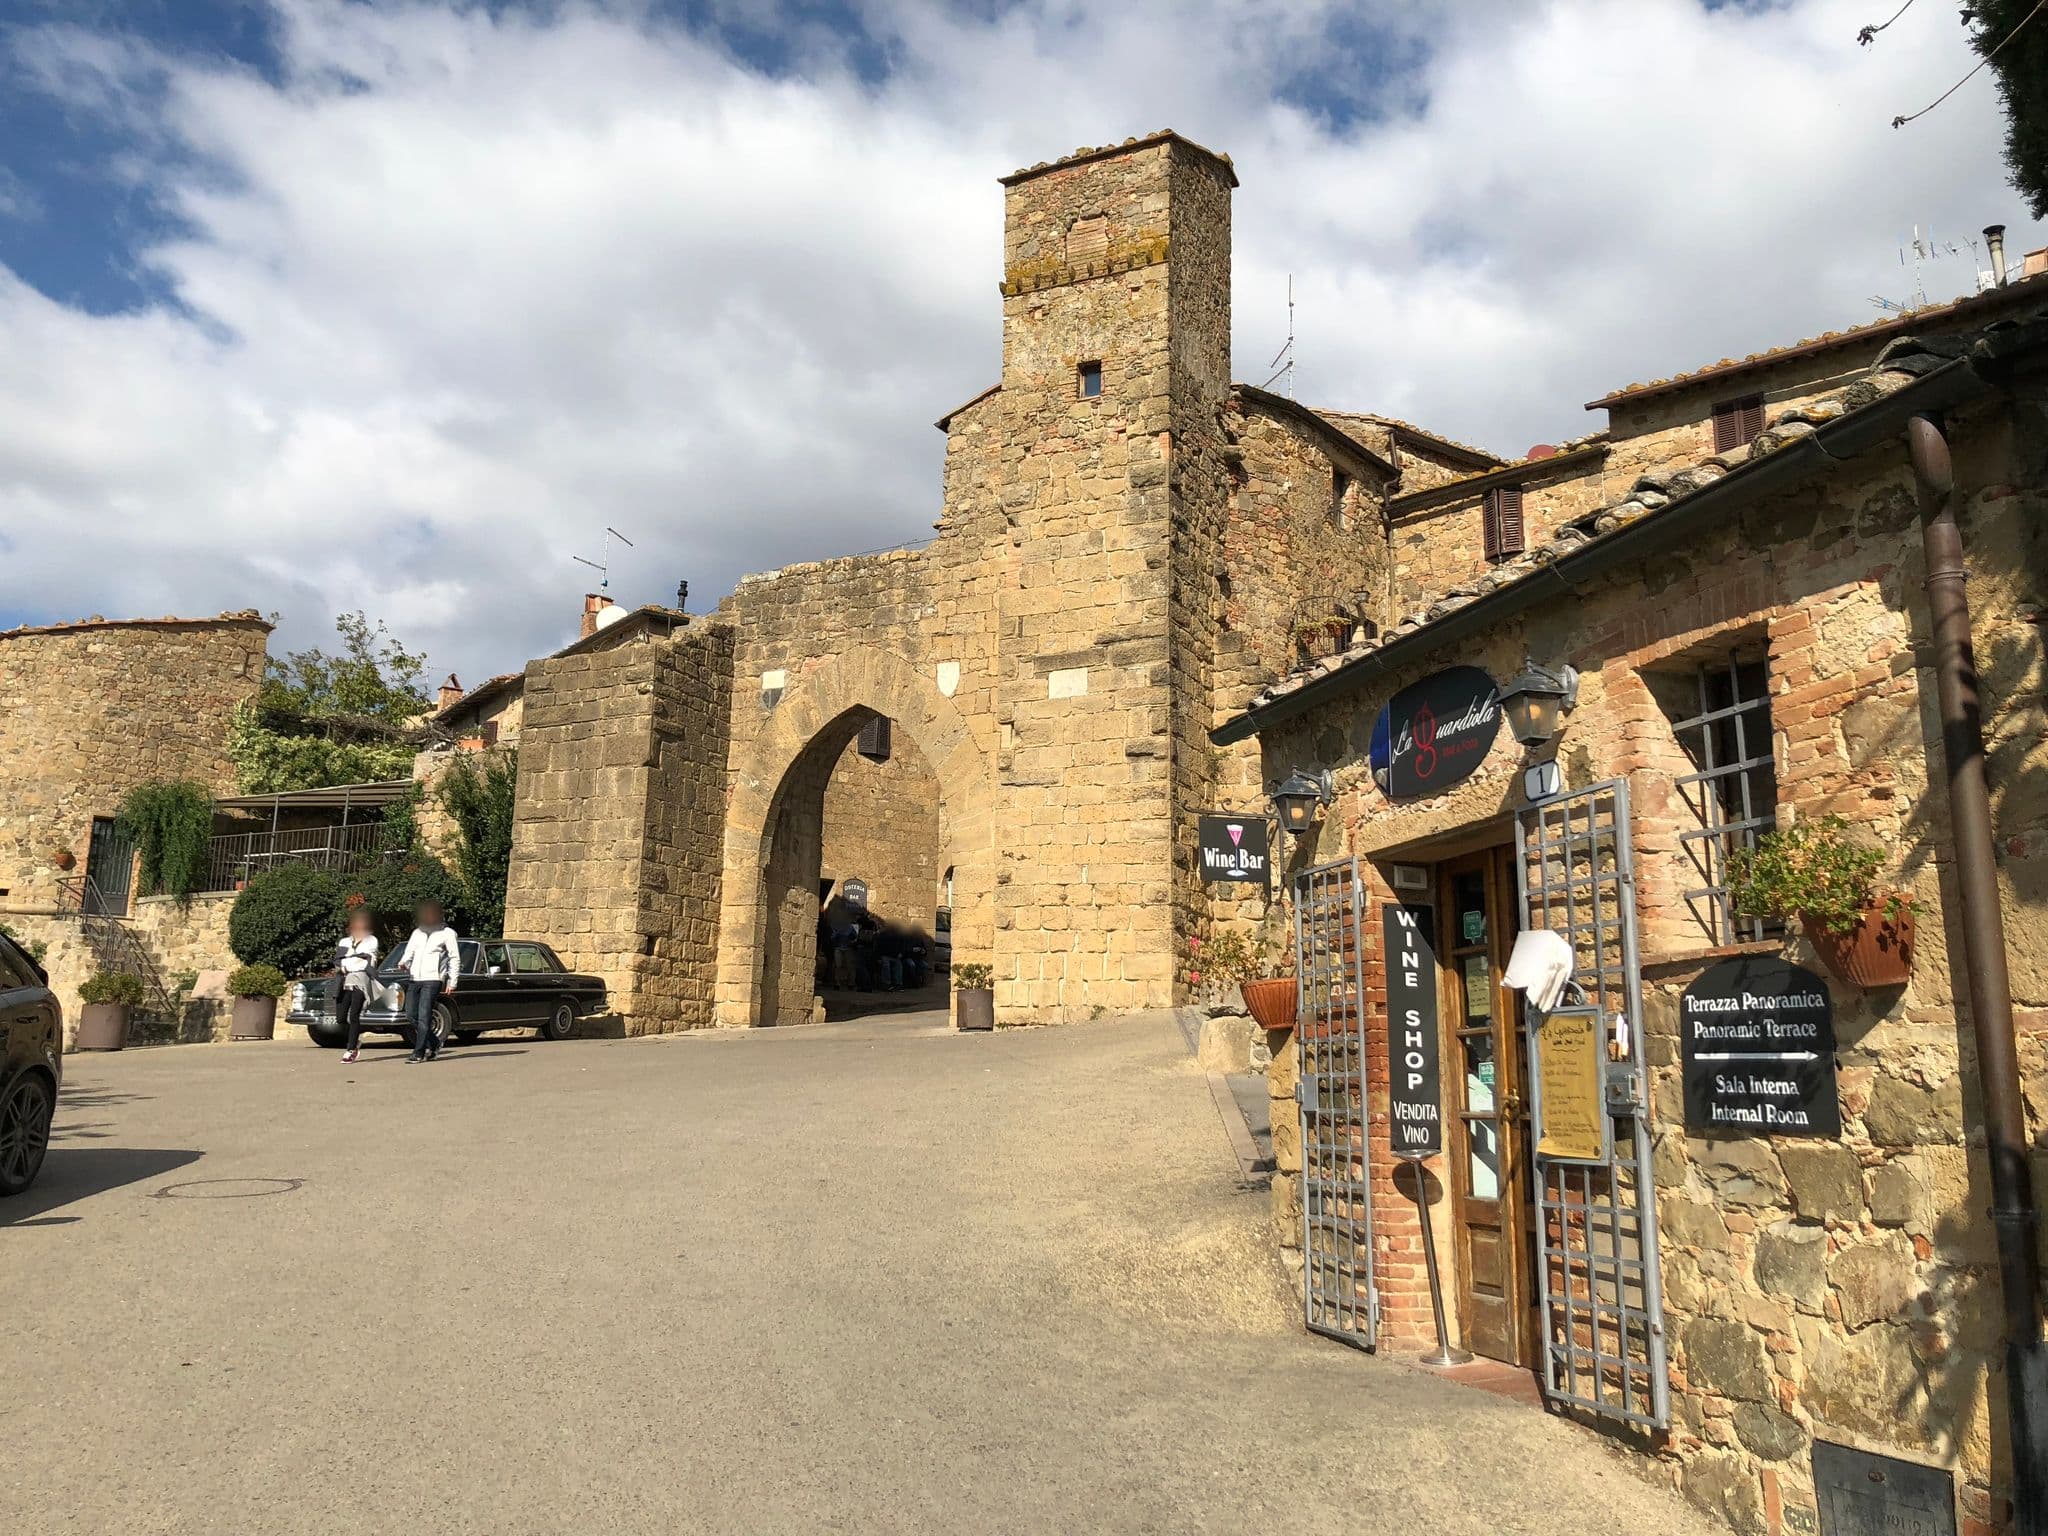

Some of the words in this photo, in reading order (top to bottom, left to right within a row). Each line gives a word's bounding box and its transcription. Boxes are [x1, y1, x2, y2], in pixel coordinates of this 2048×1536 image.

[1391, 718, 1413, 765] La
[1535, 767, 1547, 794] 1
[1203, 847, 1236, 868] Wine
[1239, 848, 1264, 869] Bar
[1396, 910, 1419, 987] WINE
[1685, 994, 1740, 1013] Terrazza
[1742, 990, 1825, 1011] Panoramica
[1693, 1020, 1761, 1039] Panoramic
[1763, 1018, 1817, 1038] Terrace
[1405, 1010, 1424, 1090] SHOP
[1715, 1074, 1747, 1094] Sala
[1749, 1074, 1800, 1096] Interna
[1393, 1100, 1438, 1121] VENDITA
[1711, 1101, 1763, 1123] Internal
[1765, 1103, 1809, 1125] Room
[1402, 1124, 1430, 1145] VINO
